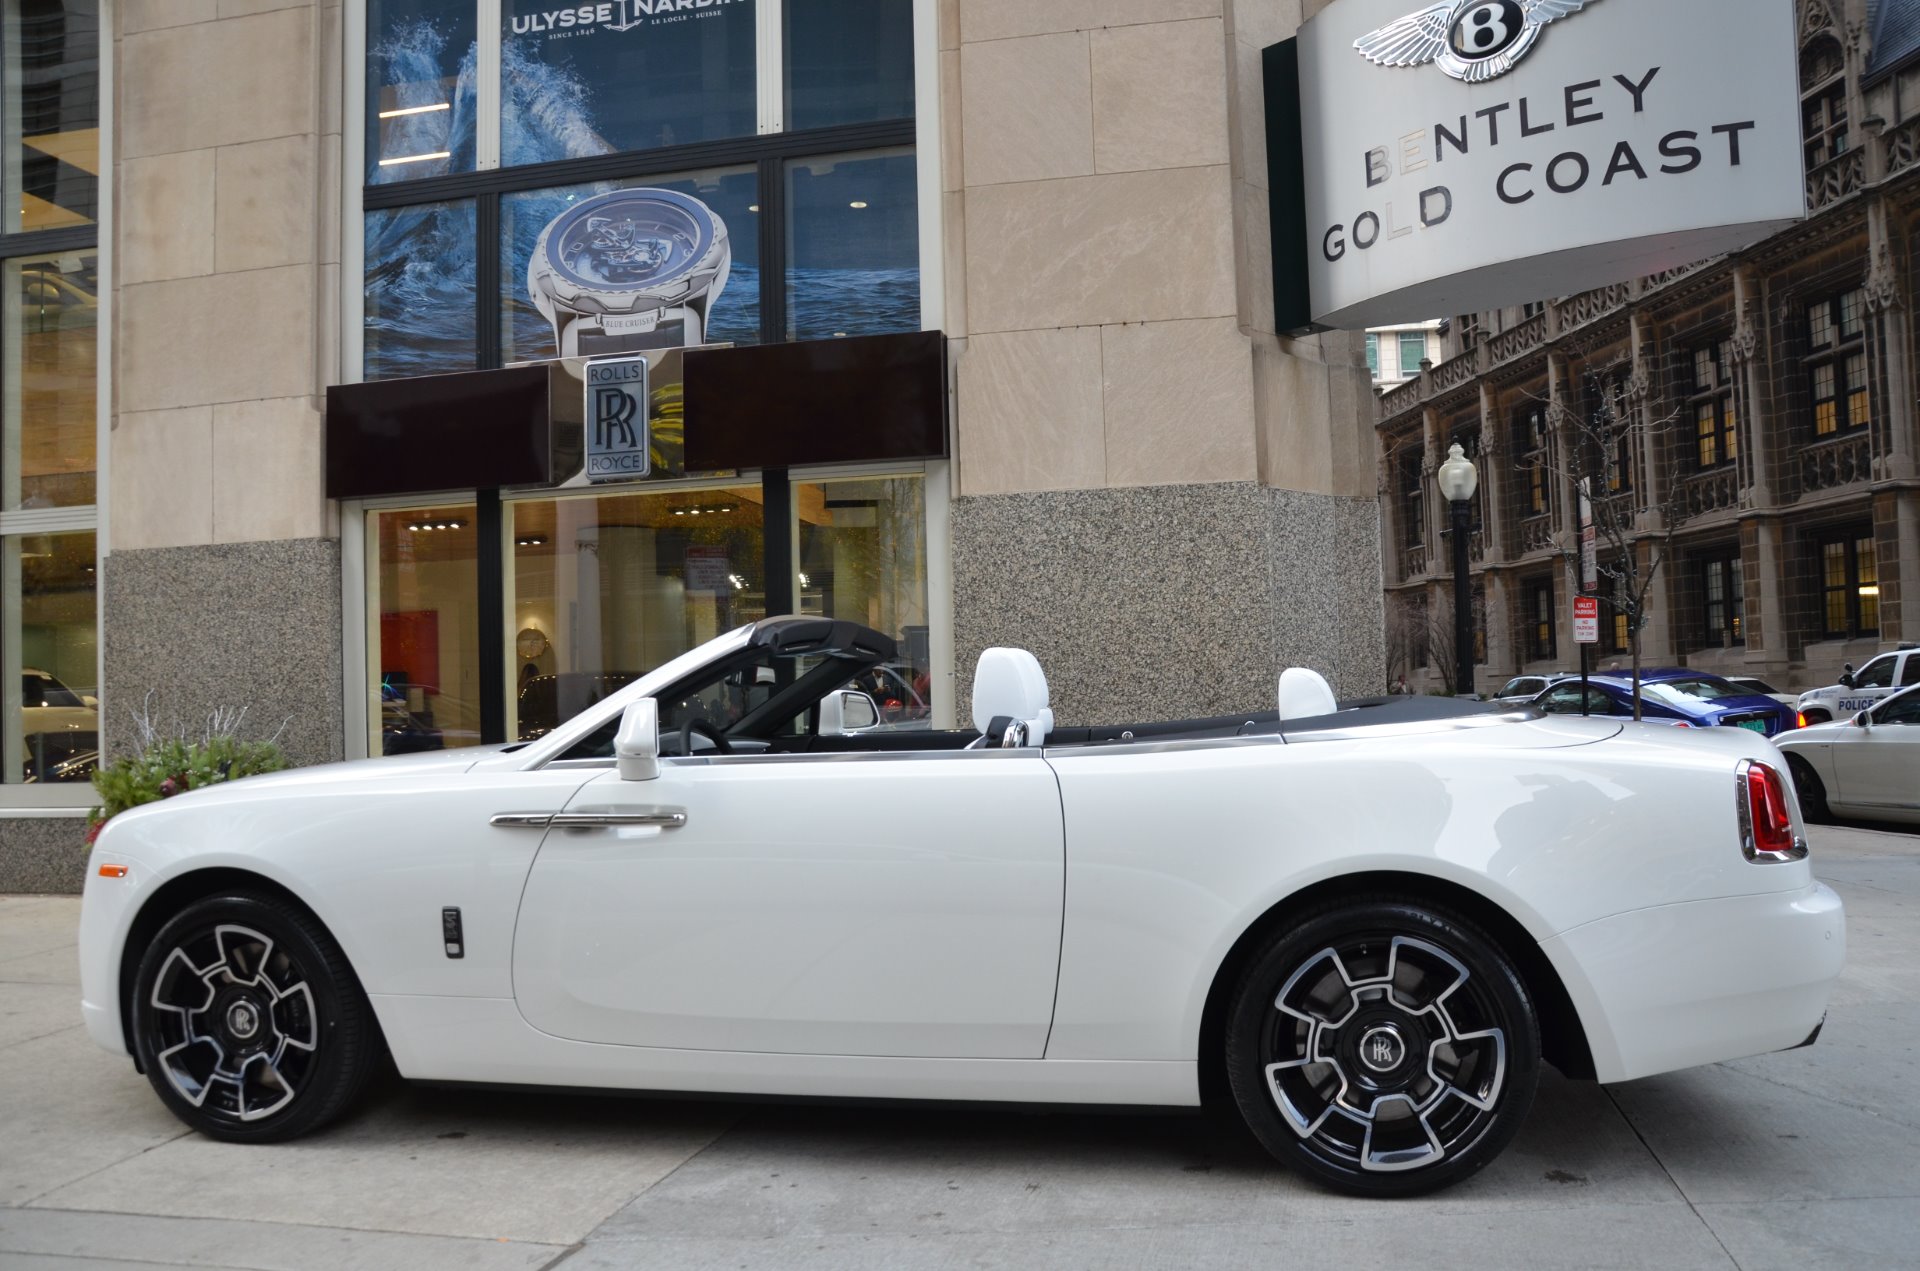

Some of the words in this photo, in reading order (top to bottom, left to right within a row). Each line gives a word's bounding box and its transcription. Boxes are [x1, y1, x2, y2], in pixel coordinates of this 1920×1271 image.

[512, 3, 612, 34] ULYSSE
[663, 14, 687, 23] LOCLE
[695, 10, 722, 19] SUISSE
[548, 32, 573, 40] SINCE
[576, 28, 595, 36] 1846
[1461, 2, 1508, 54] B
[1364, 66, 1662, 188] BENTLEY
[1322, 185, 1453, 262] GOLD
[1496, 120, 1755, 205] COAST
[605, 320, 624, 328] BLUE
[625, 316, 655, 328] CRUISER
[590, 365, 639, 381] ROLLS
[591, 455, 640, 471] ROYCE
[1838, 699, 1874, 711] POLICE
